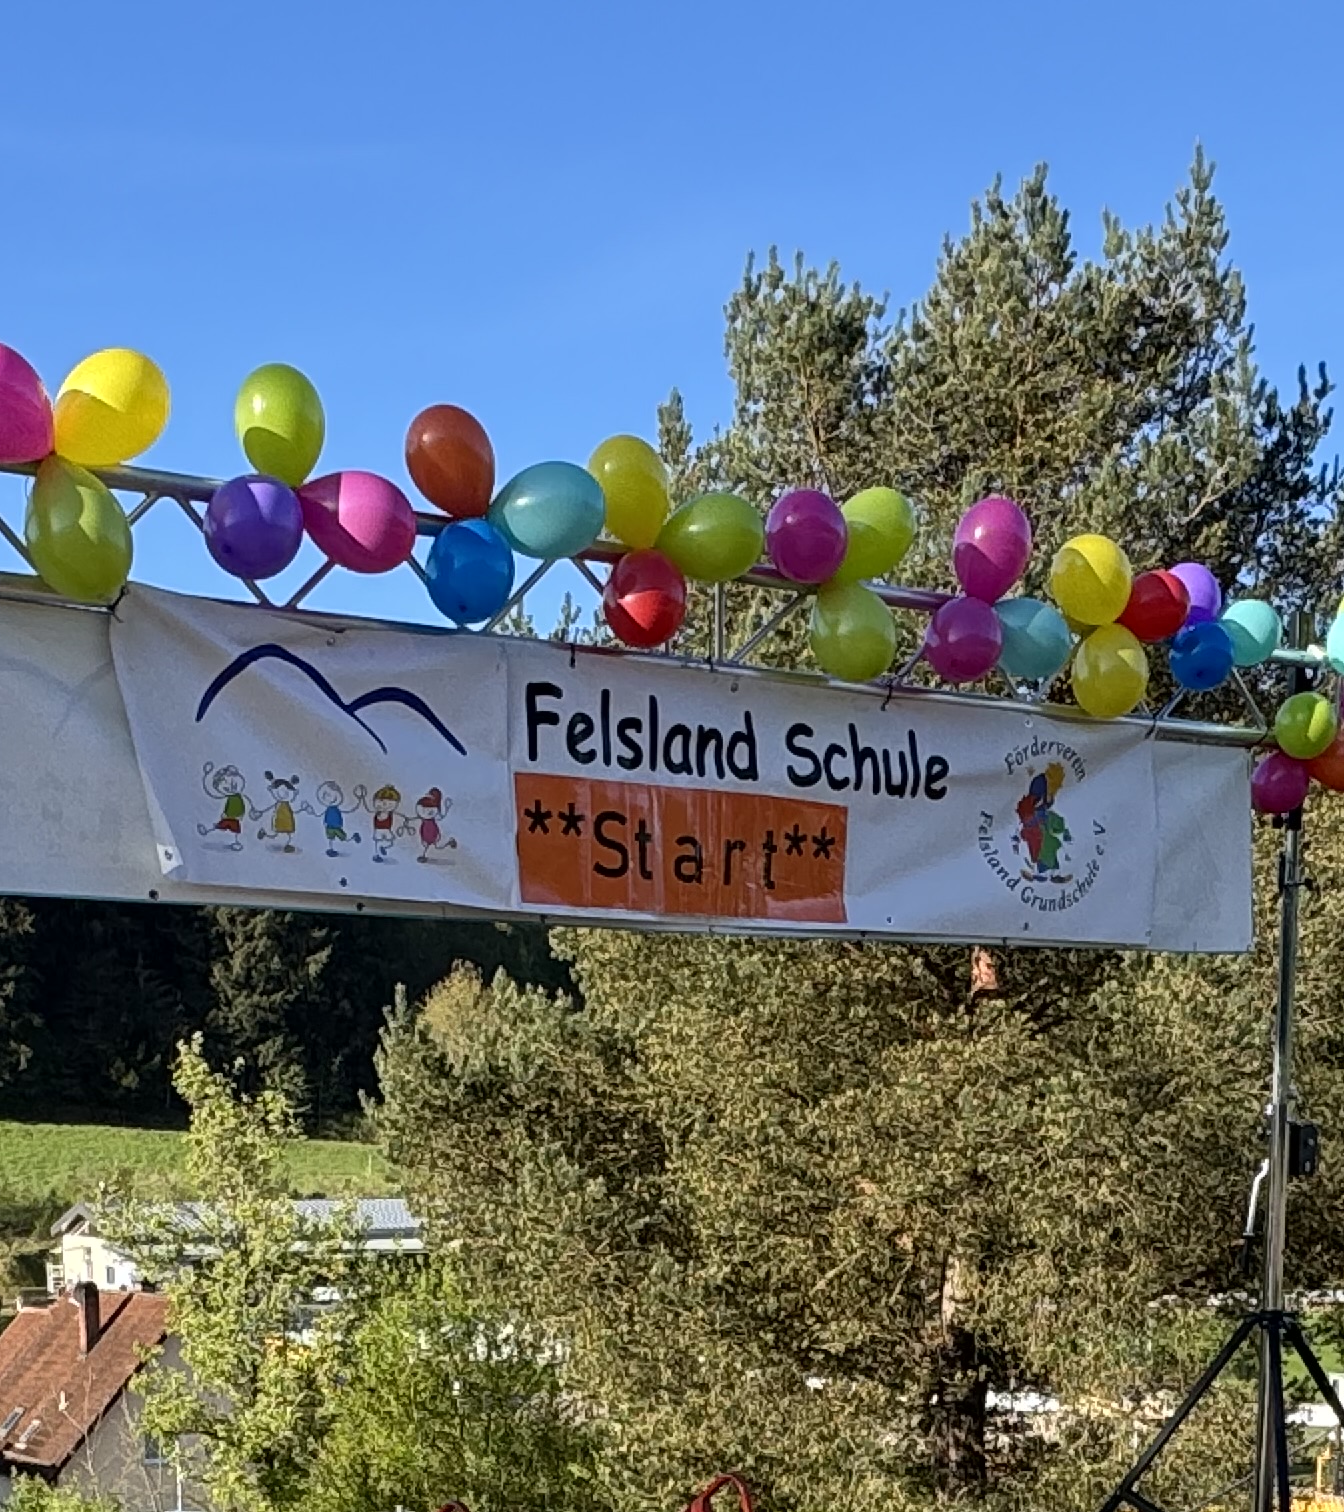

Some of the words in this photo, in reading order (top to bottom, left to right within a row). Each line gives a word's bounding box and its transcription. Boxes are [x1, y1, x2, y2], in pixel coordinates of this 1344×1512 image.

[525, 682, 759, 782] Felsland
[785, 722, 950, 800] Schule
[1004, 735, 1087, 782] Förderverein
[978, 811, 1021, 891] Felsland
[1020, 858, 1100, 912] Grundschule
